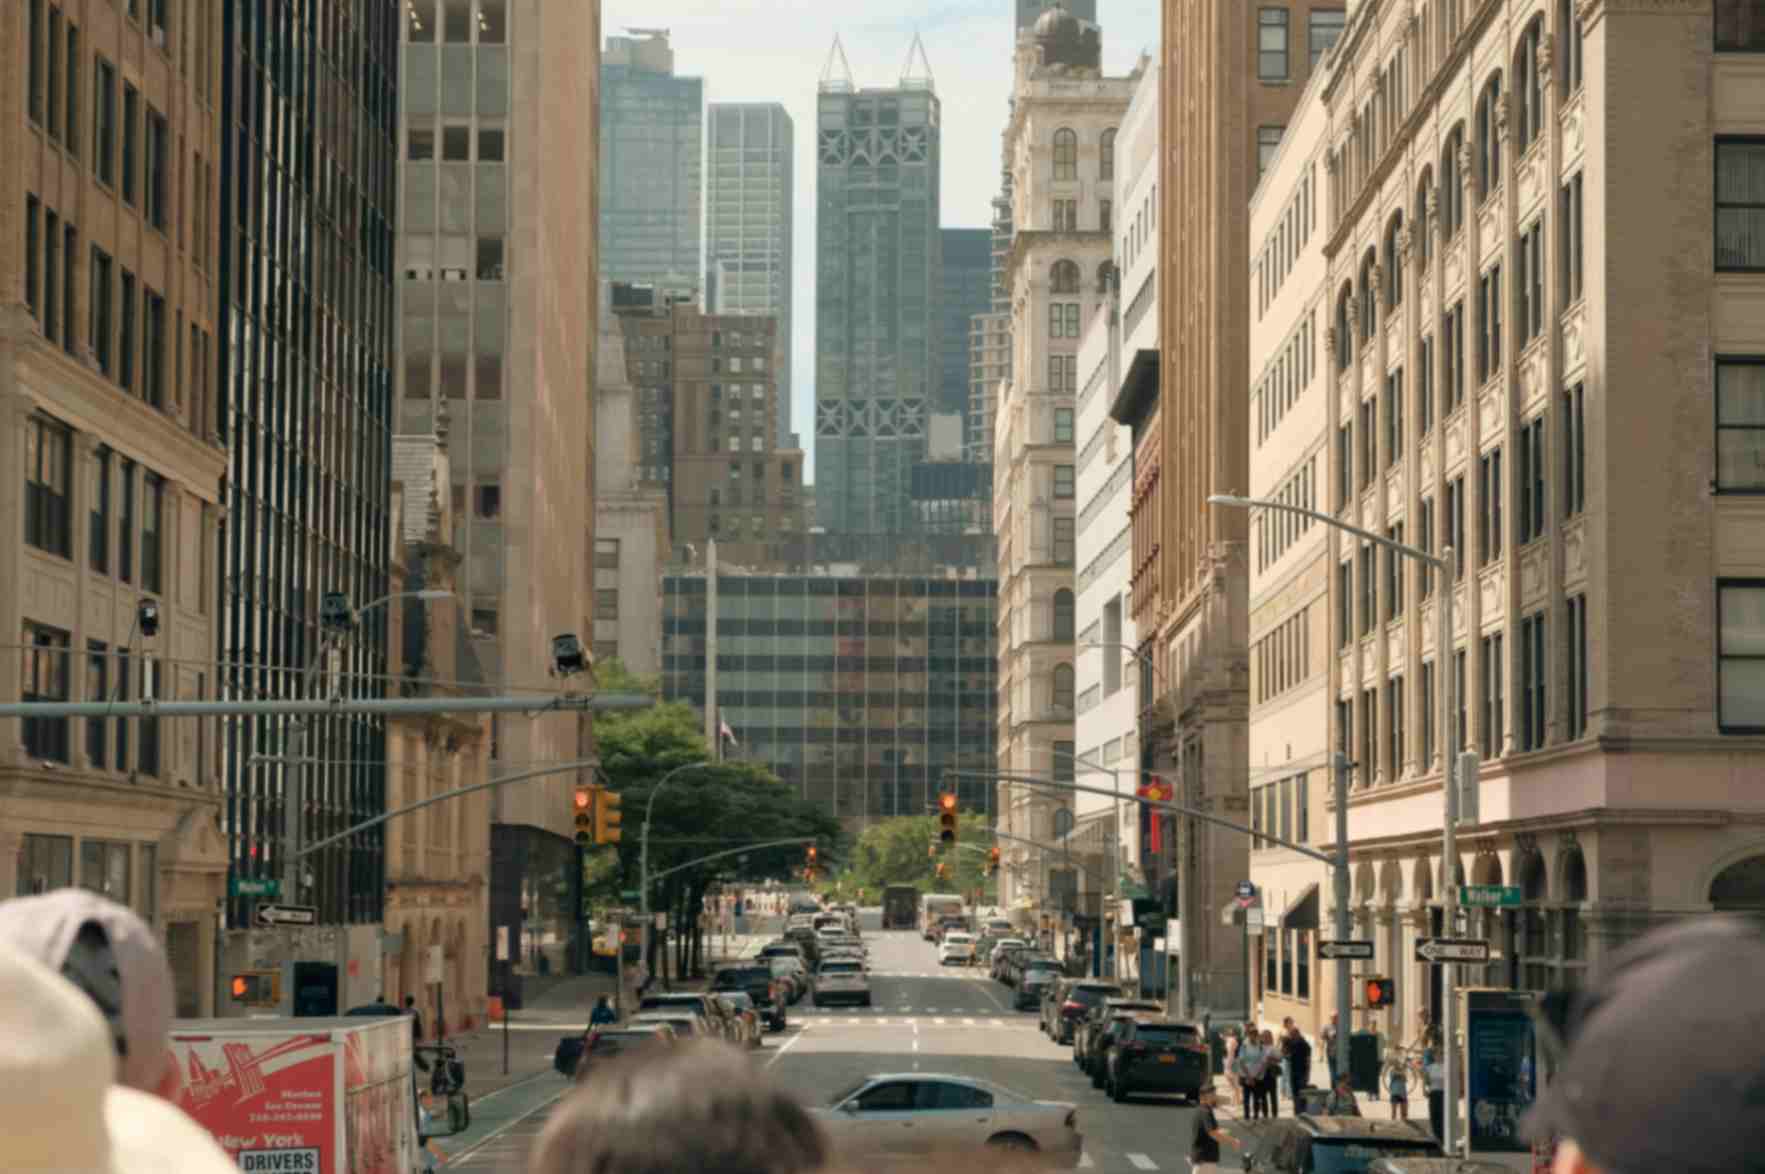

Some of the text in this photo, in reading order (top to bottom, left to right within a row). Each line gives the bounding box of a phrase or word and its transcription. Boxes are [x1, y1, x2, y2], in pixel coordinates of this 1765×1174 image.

[1424, 945, 1483, 957] ONE WAY
[263, 1133, 304, 1148] York
[244, 1151, 314, 1171] DRIVERS
